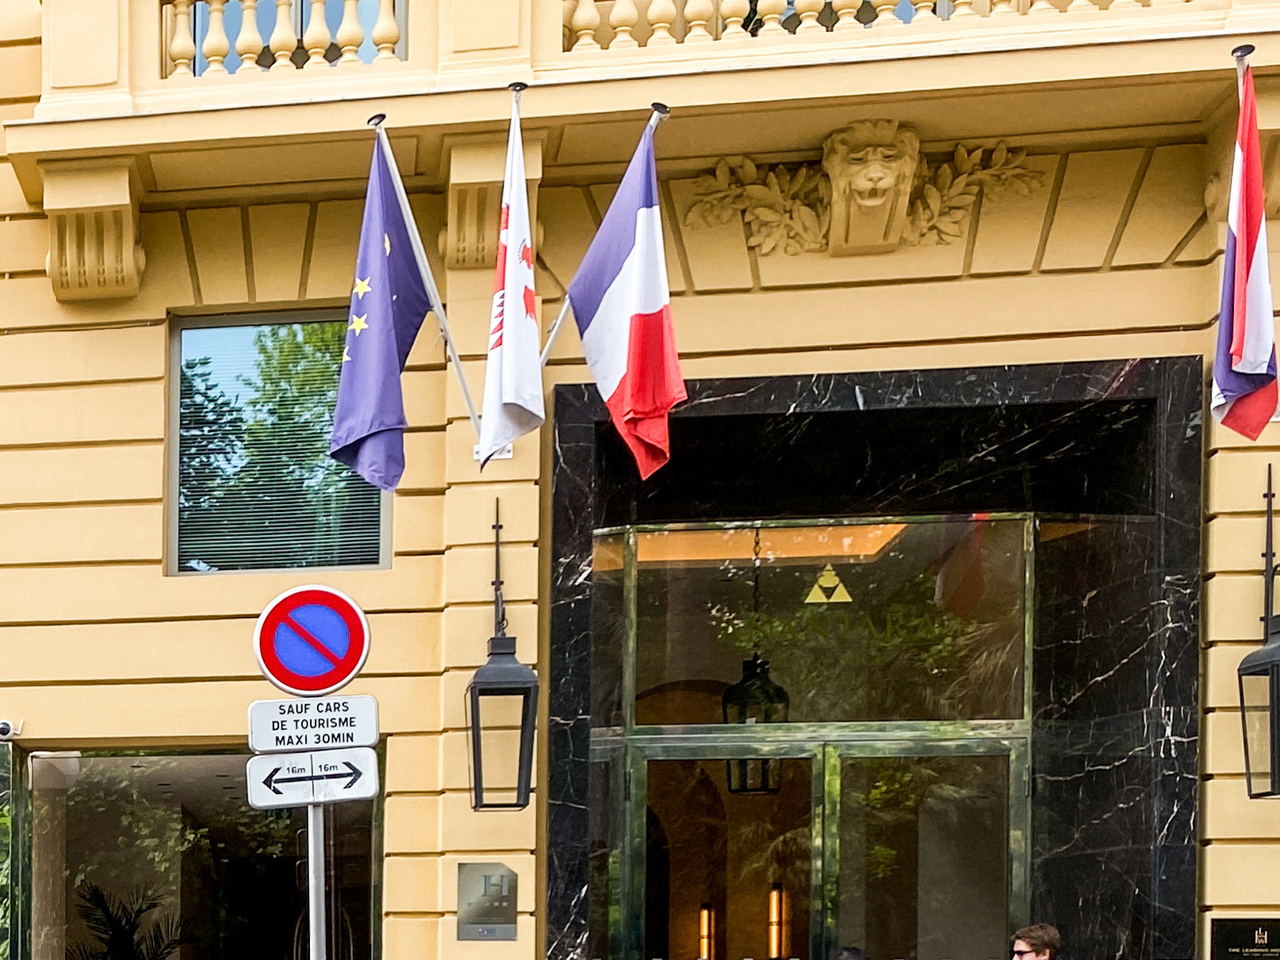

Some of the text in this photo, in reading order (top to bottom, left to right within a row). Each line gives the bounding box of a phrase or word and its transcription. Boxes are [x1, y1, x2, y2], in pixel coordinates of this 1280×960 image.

[723, 612, 939, 638] NANTARA
[278, 701, 350, 715] SAUF CARS
[272, 716, 357, 731] DE TOURISME
[275, 732, 355, 747] MAXI 30MIN
[286, 765, 306, 775] 16m
[318, 763, 339, 773] 16m
[481, 874, 511, 897] H
